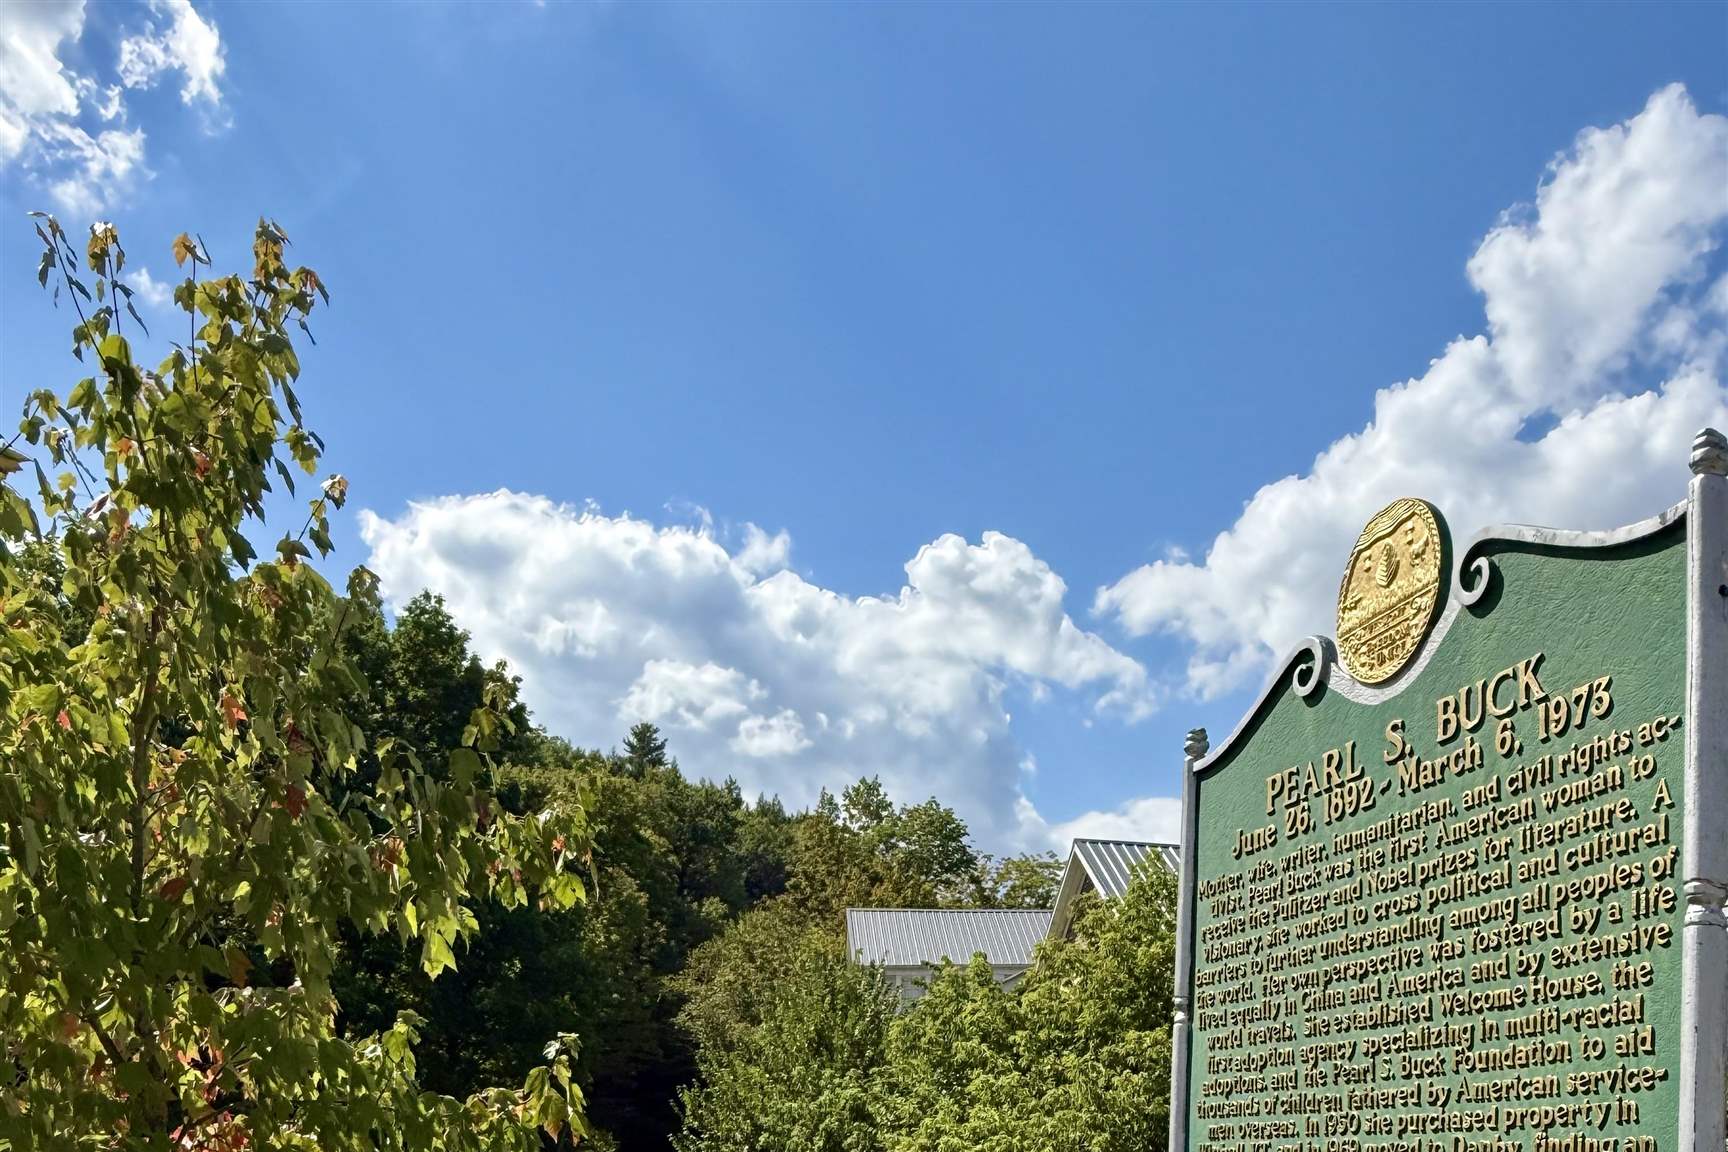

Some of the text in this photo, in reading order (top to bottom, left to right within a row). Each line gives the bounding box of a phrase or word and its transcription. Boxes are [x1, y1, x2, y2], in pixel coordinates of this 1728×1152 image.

[1232, 824, 1277, 858] June
[1284, 800, 1314, 838] 26,
[1323, 776, 1375, 823] 1892
[1397, 735, 1483, 795] March
[1494, 717, 1522, 757] 6,
[1537, 675, 1612, 741] 1973
[1264, 653, 1547, 815] PEARL S. BUCK
[1198, 874, 1246, 900] Mother,
[1247, 859, 1278, 883] wife,
[1279, 842, 1326, 872] writer,
[1333, 798, 1456, 854] humanitarian,
[1462, 775, 1500, 809] and
[1505, 755, 1552, 795] civil
[1557, 730, 1633, 778] rights
[1201, 779, 1673, 943] receive the Pulitzer and Nobel prizes for literature. A
[1248, 874, 1284, 906] Pearl
[1287, 864, 1322, 893] Buck
[1324, 858, 1355, 882] was
[1358, 844, 1386, 871] the
[1389, 826, 1428, 861] first
[1436, 791, 1536, 846] American
[1540, 766, 1623, 812] woman
[1629, 752, 1656, 781] to
[1195, 847, 1678, 988] barriers to further understanding among all peoples of
[1197, 988, 1216, 1009] the
[1262, 973, 1289, 996] Her
[1290, 969, 1320, 990] own
[1322, 945, 1423, 988] perspective
[1428, 934, 1465, 961] was
[1471, 907, 1560, 952] fostered
[1569, 903, 1601, 938] by
[1607, 900, 1622, 923] a
[1630, 883, 1676, 919] life
[1203, 815, 1667, 964] visionary, she worked to cross political and cultural
[1199, 921, 1671, 1030] lived equally in China and America and by extensive
[1207, 1028, 1243, 1052] world
[1303, 1013, 1330, 1037] She
[1333, 995, 1432, 1033] established
[1437, 980, 1528, 1016] Welcome
[1610, 959, 1653, 990] the
[1208, 992, 1643, 1076] first adoption agency specializing in multi-racial
[1196, 1098, 1261, 1119] thousands
[1264, 1094, 1279, 1115] of
[1280, 1092, 1343, 1114] children
[1346, 1082, 1421, 1109] fathered
[1426, 1081, 1449, 1110] by
[1455, 1073, 1559, 1102] American
[1208, 1124, 1235, 1141] men
[1304, 1118, 1320, 1137] In
[1325, 1113, 1362, 1136] 1950
[1364, 1111, 1393, 1134] she
[1397, 1104, 1498, 1138] purchased
[1503, 1098, 1610, 1134] property
[1614, 1096, 1639, 1123] in
[1270, 1067, 1298, 1090] and
[1304, 1064, 1328, 1087] the
[1332, 1058, 1377, 1084] Pearl
[1380, 1055, 1396, 1078] S.
[1399, 1052, 1445, 1077] Buck
[1451, 1037, 1573, 1072] Foundation
[1580, 1035, 1605, 1059] to
[1614, 1024, 1654, 1056] aid
